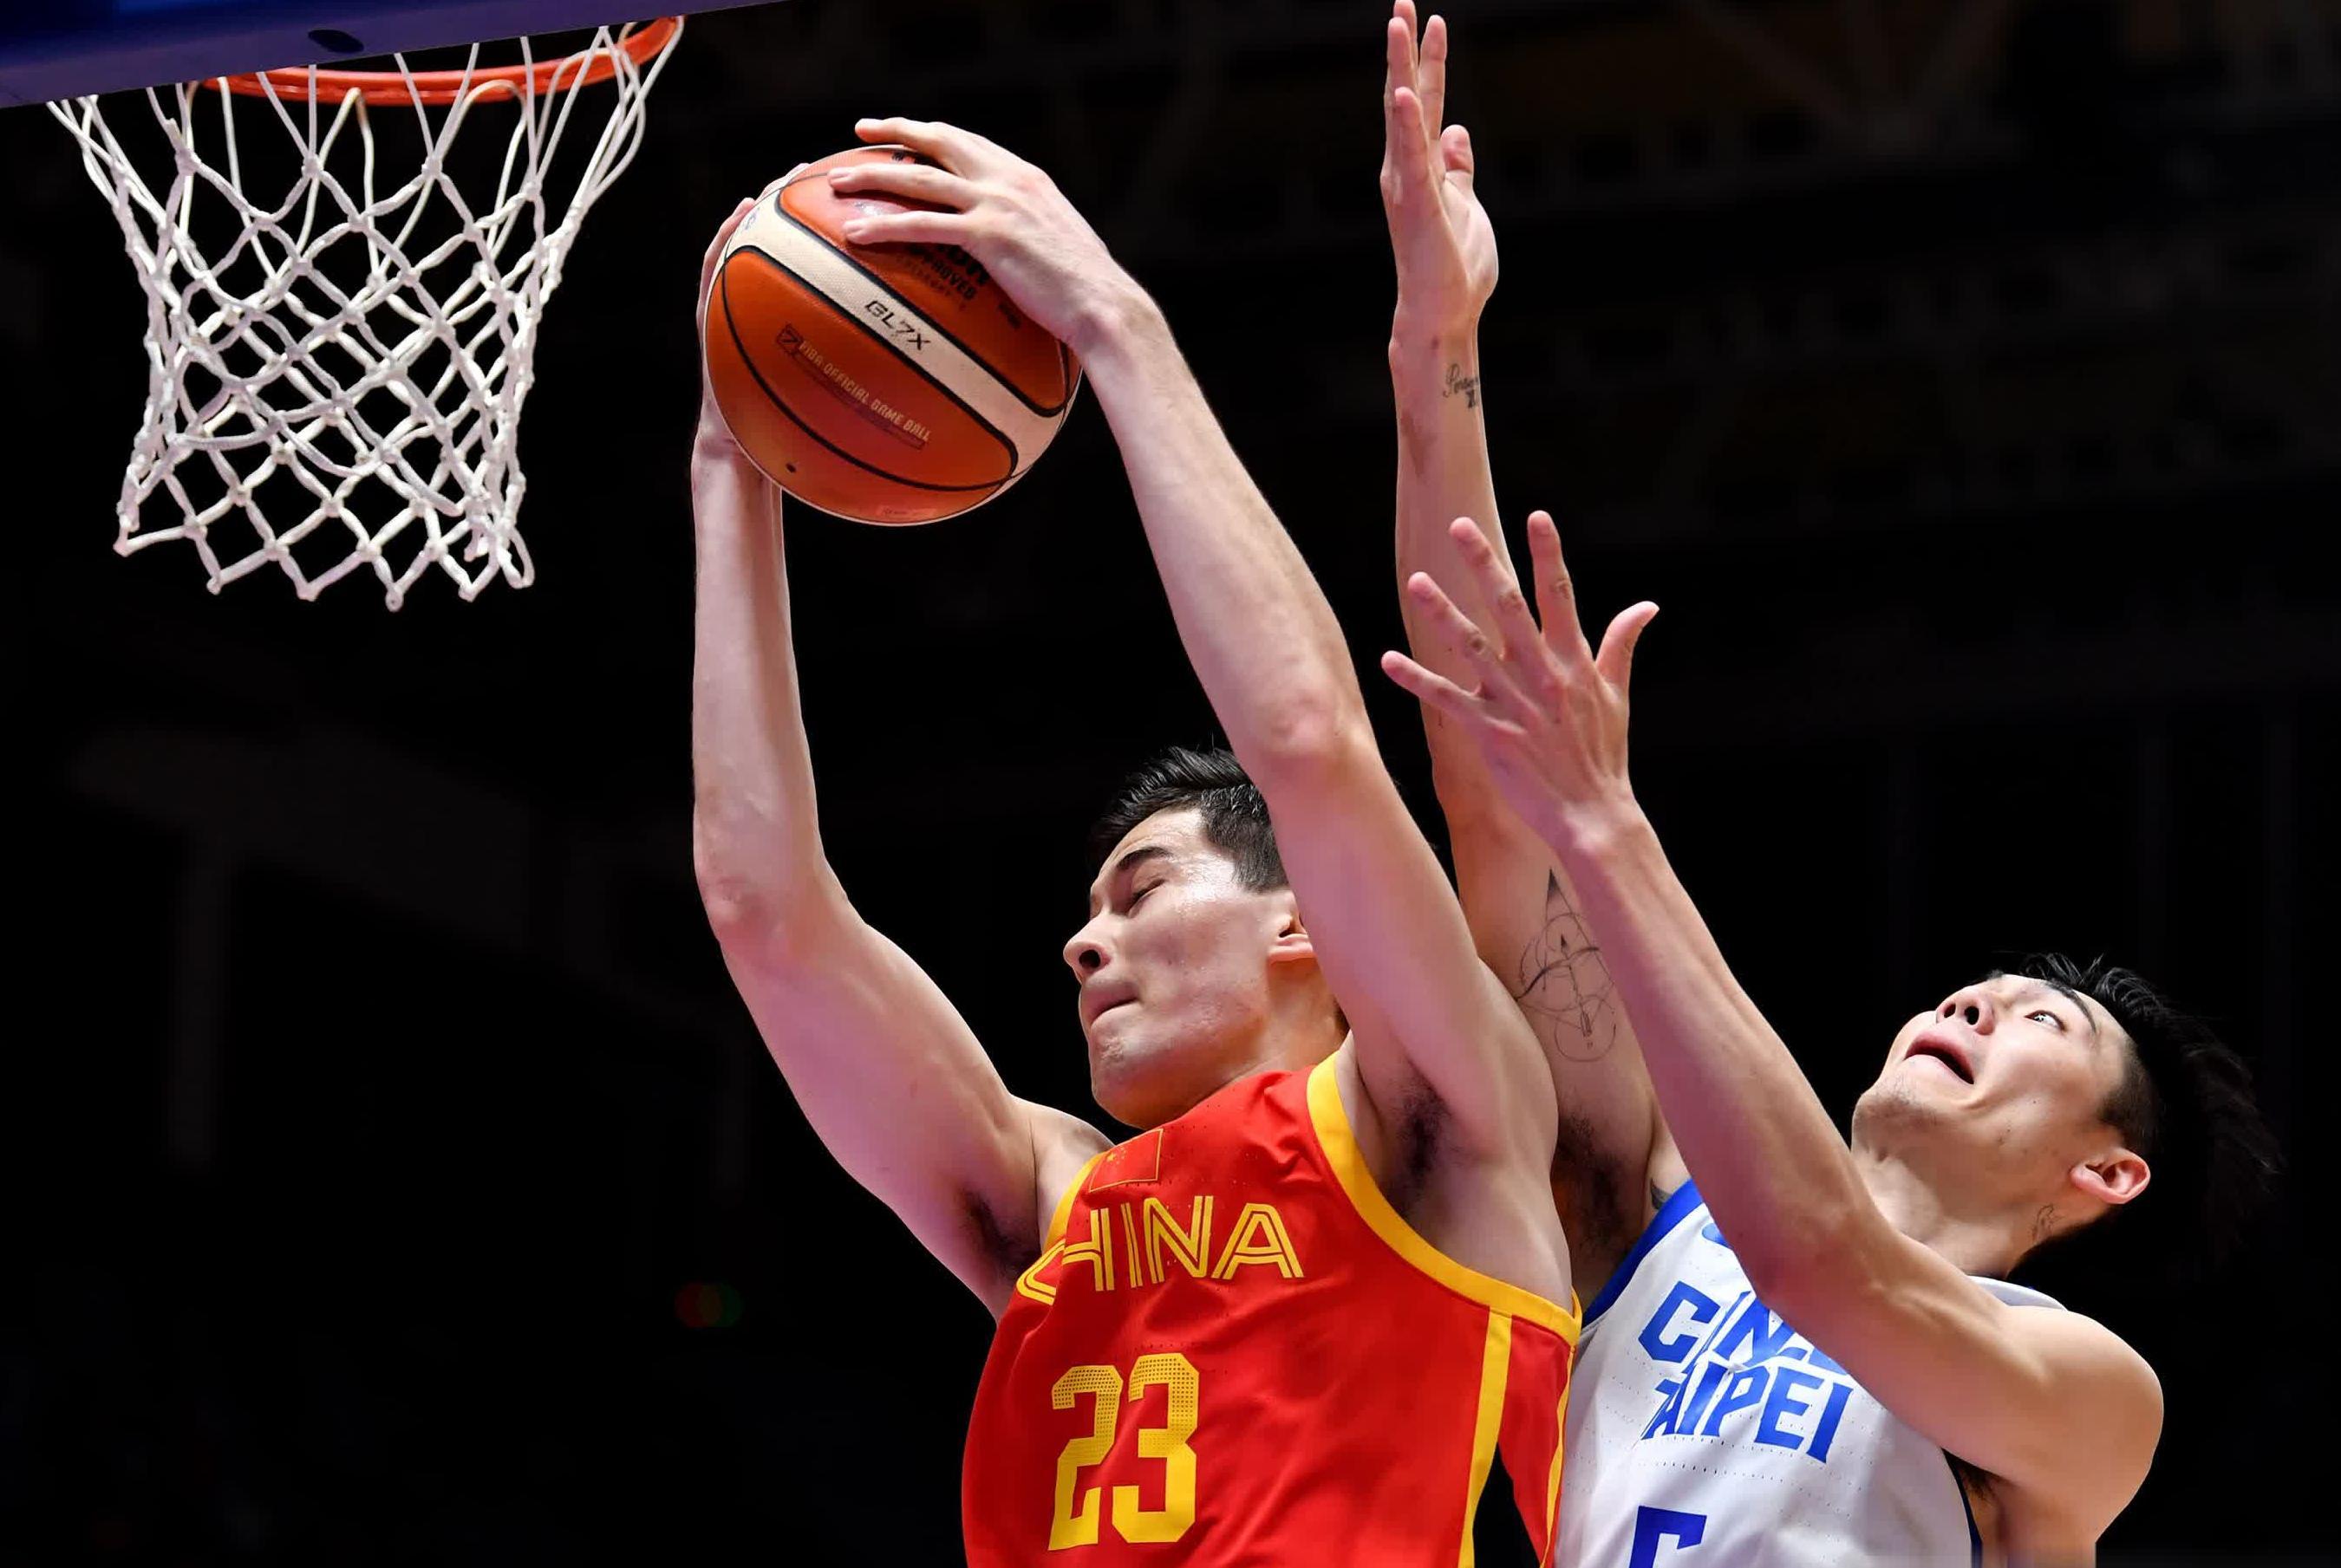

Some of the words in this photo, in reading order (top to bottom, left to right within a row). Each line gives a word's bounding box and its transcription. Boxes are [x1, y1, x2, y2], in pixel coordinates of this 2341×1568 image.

[864, 300, 931, 350] GL7X
[823, 362, 871, 403] OFFICIAL
[871, 398, 904, 425] GAME
[903, 419, 931, 441] BALL
[1016, 1195, 1304, 1305] CHINA
[1047, 1352, 1200, 1551] 23
